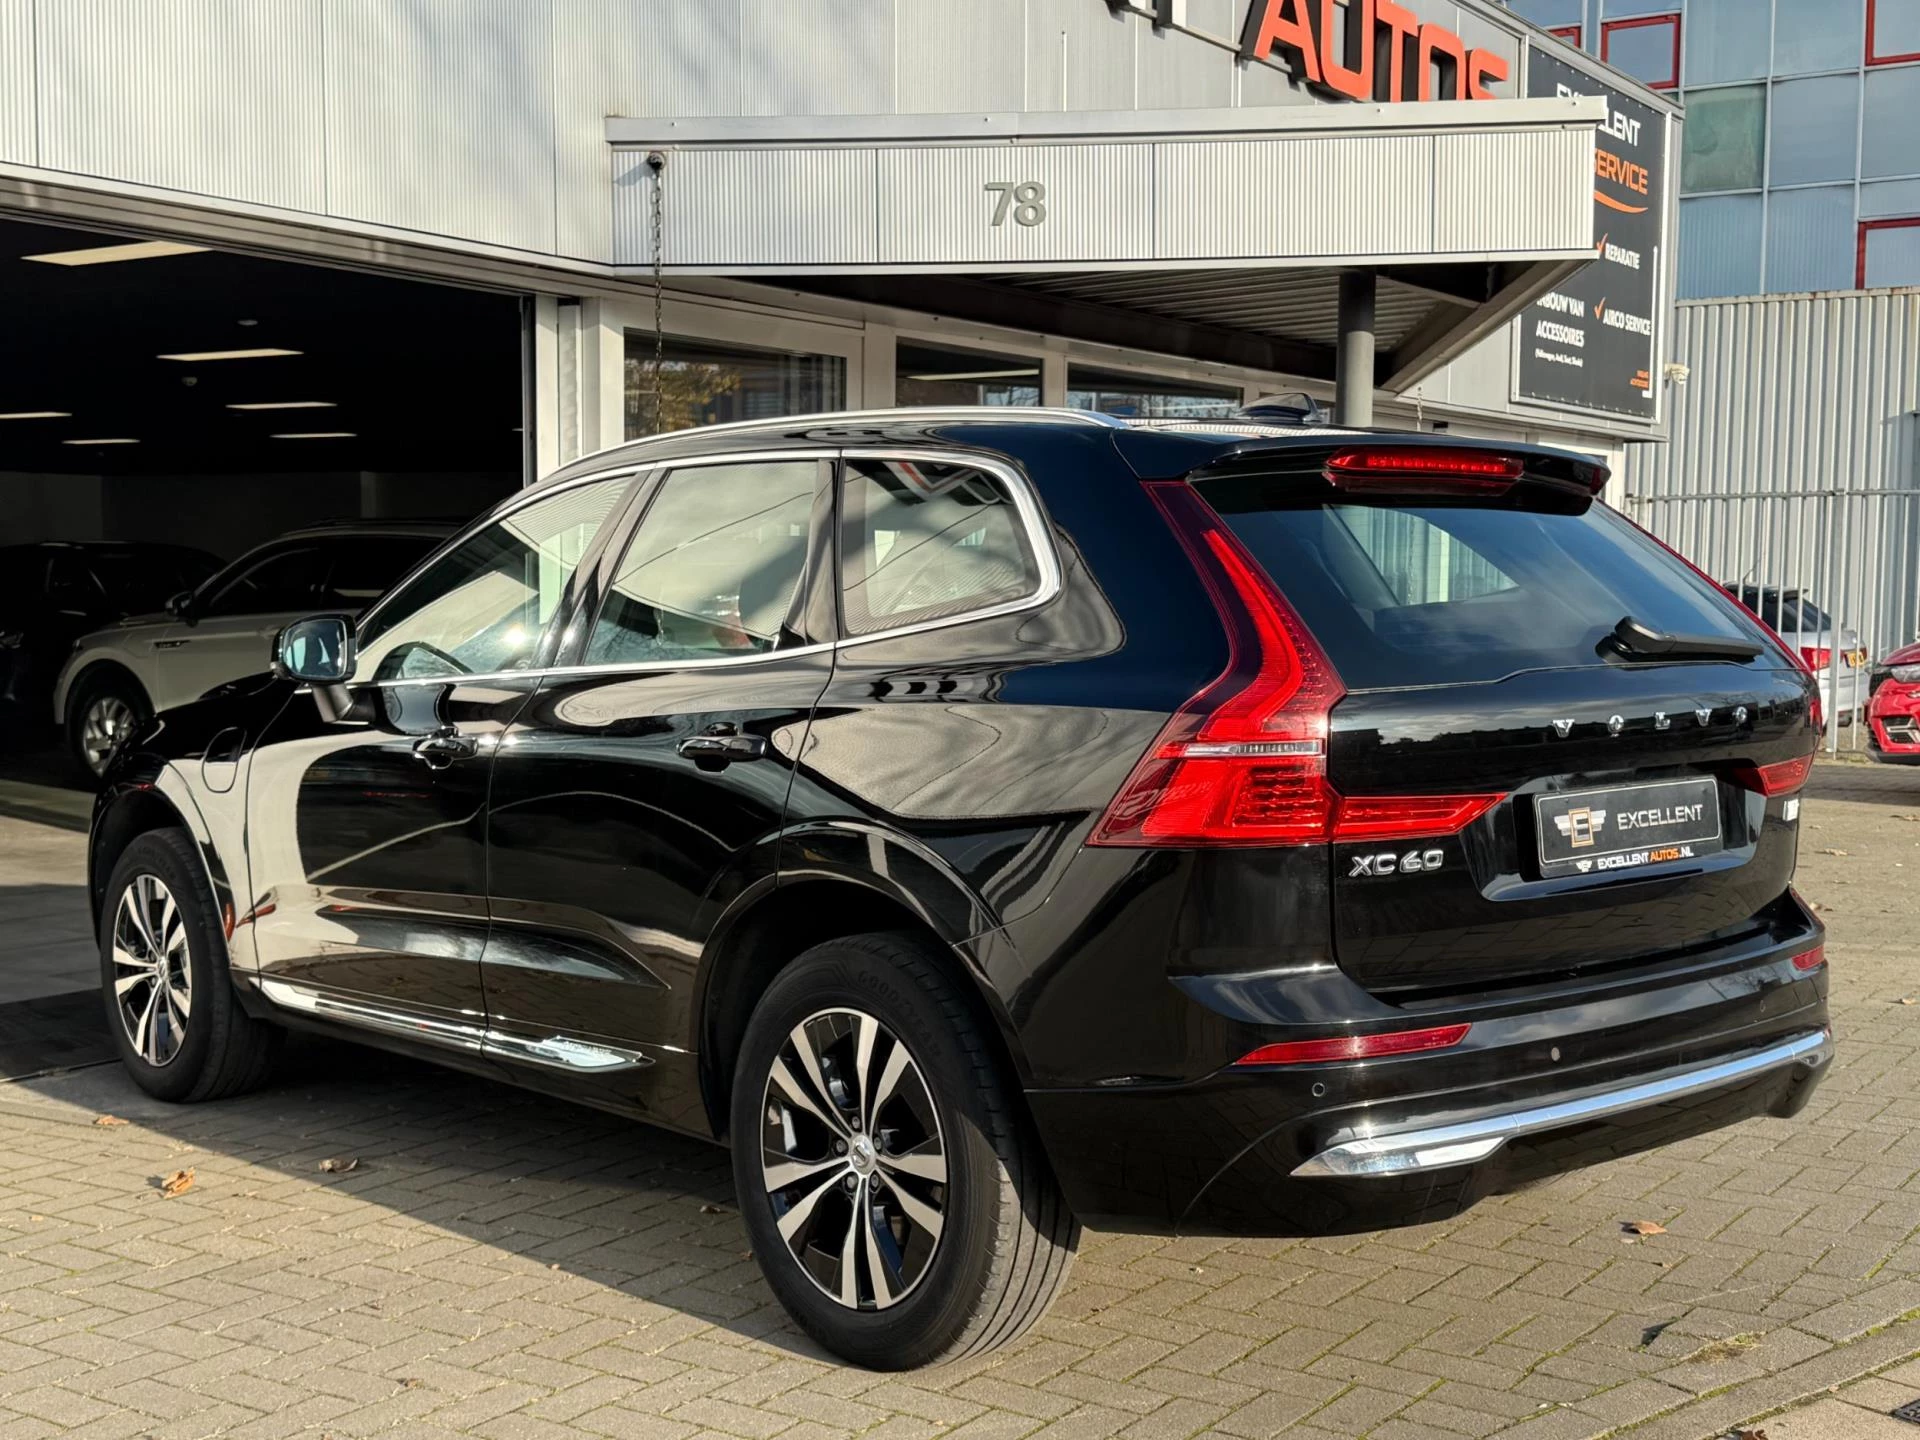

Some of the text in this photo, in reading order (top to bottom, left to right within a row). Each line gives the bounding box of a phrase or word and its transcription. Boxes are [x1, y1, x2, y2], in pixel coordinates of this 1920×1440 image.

[984, 181, 1047, 227] 78
[1605, 243, 1640, 270] REPARATIE
[1568, 297, 1584, 318] VAN
[1535, 319, 1585, 348] ACCESSOIRES
[1603, 308, 1652, 336] AIRCO SERVICE
[1552, 706, 1749, 738] VOLVO
[1617, 804, 1703, 831] EXCELLENT
